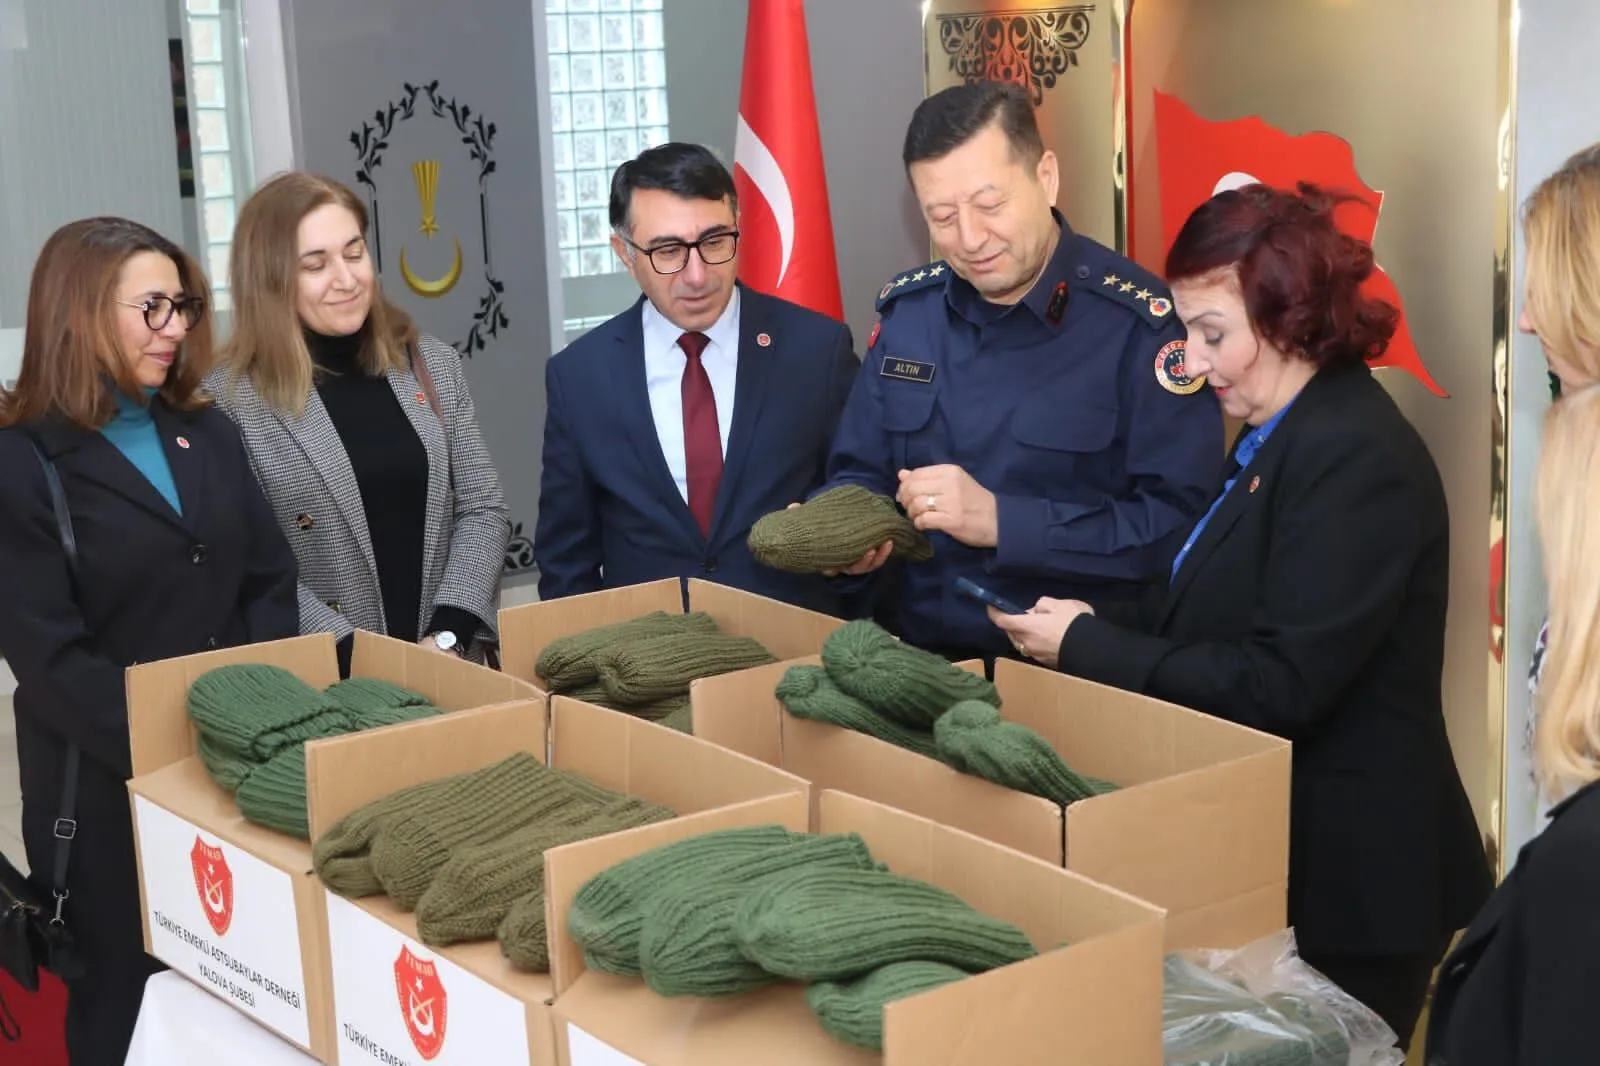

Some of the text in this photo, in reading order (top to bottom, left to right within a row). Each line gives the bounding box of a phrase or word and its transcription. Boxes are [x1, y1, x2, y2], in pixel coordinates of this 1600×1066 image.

[894, 362, 920, 376] ALTIN
[153, 910, 300, 1009] TÜRKİYE EMEKLİ ASTSUBAYLAR DERNEĞİ
[198, 962, 256, 1008] YALOVA ŞUBESİ
[343, 1023, 378, 1058] TÜRKİYE
